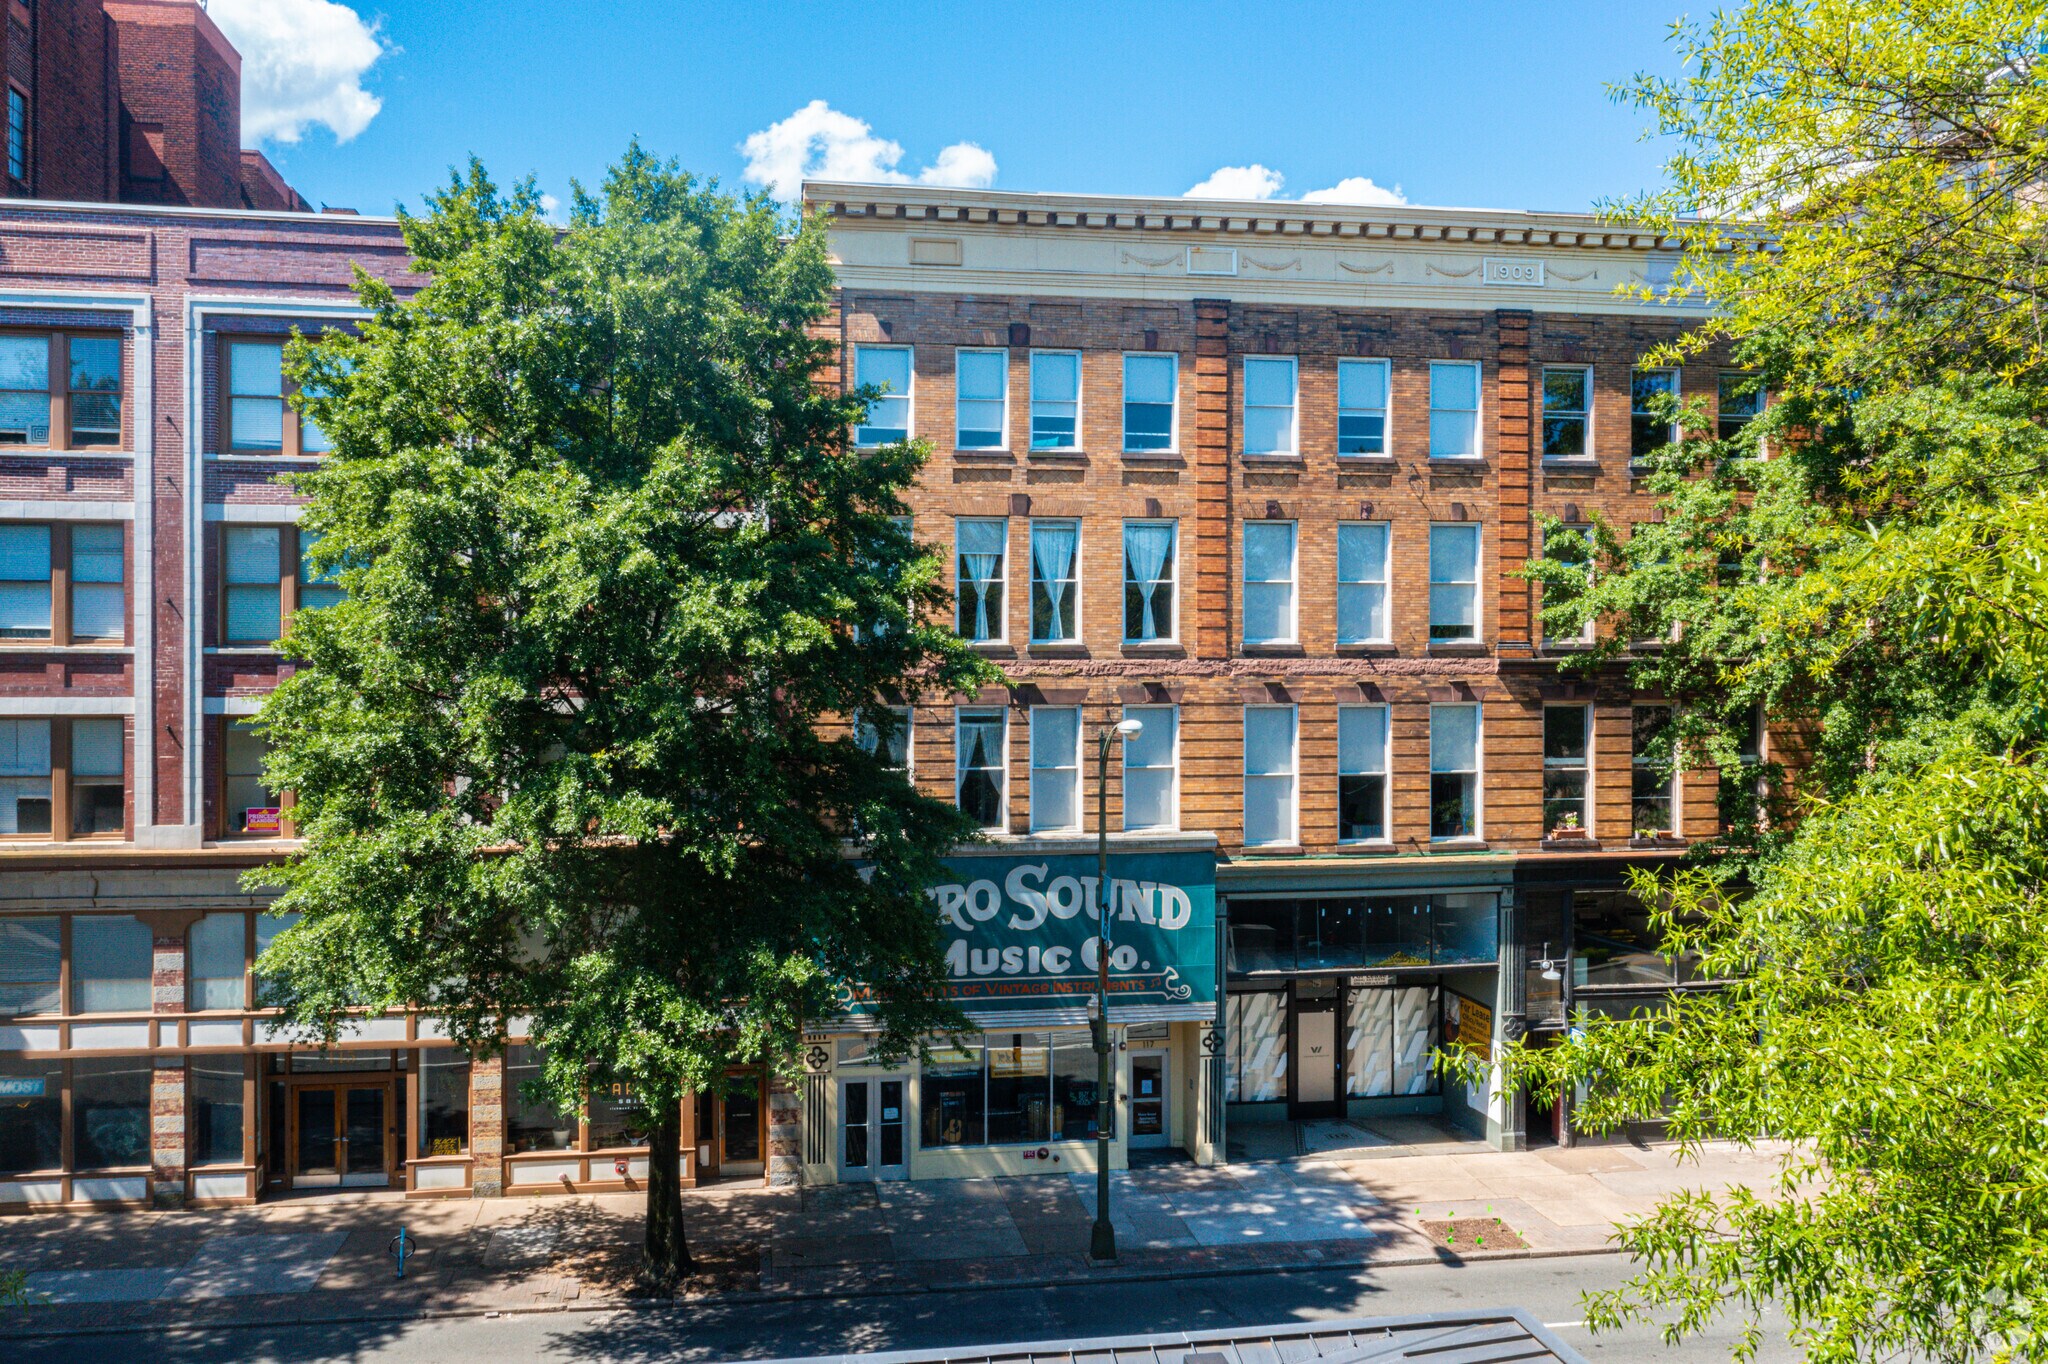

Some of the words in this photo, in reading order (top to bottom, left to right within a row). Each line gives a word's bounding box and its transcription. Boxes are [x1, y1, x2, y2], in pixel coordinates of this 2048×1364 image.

[1493, 265, 1534, 279] 1909
[1005, 863, 1191, 931] SOUND
[945, 938, 1072, 977] MUSIC
[962, 985, 981, 996] OF
[985, 982, 1049, 995] VINTAGE
[1053, 979, 1145, 994] INSTRENTS
[1471, 1005, 1490, 1022] Lease
